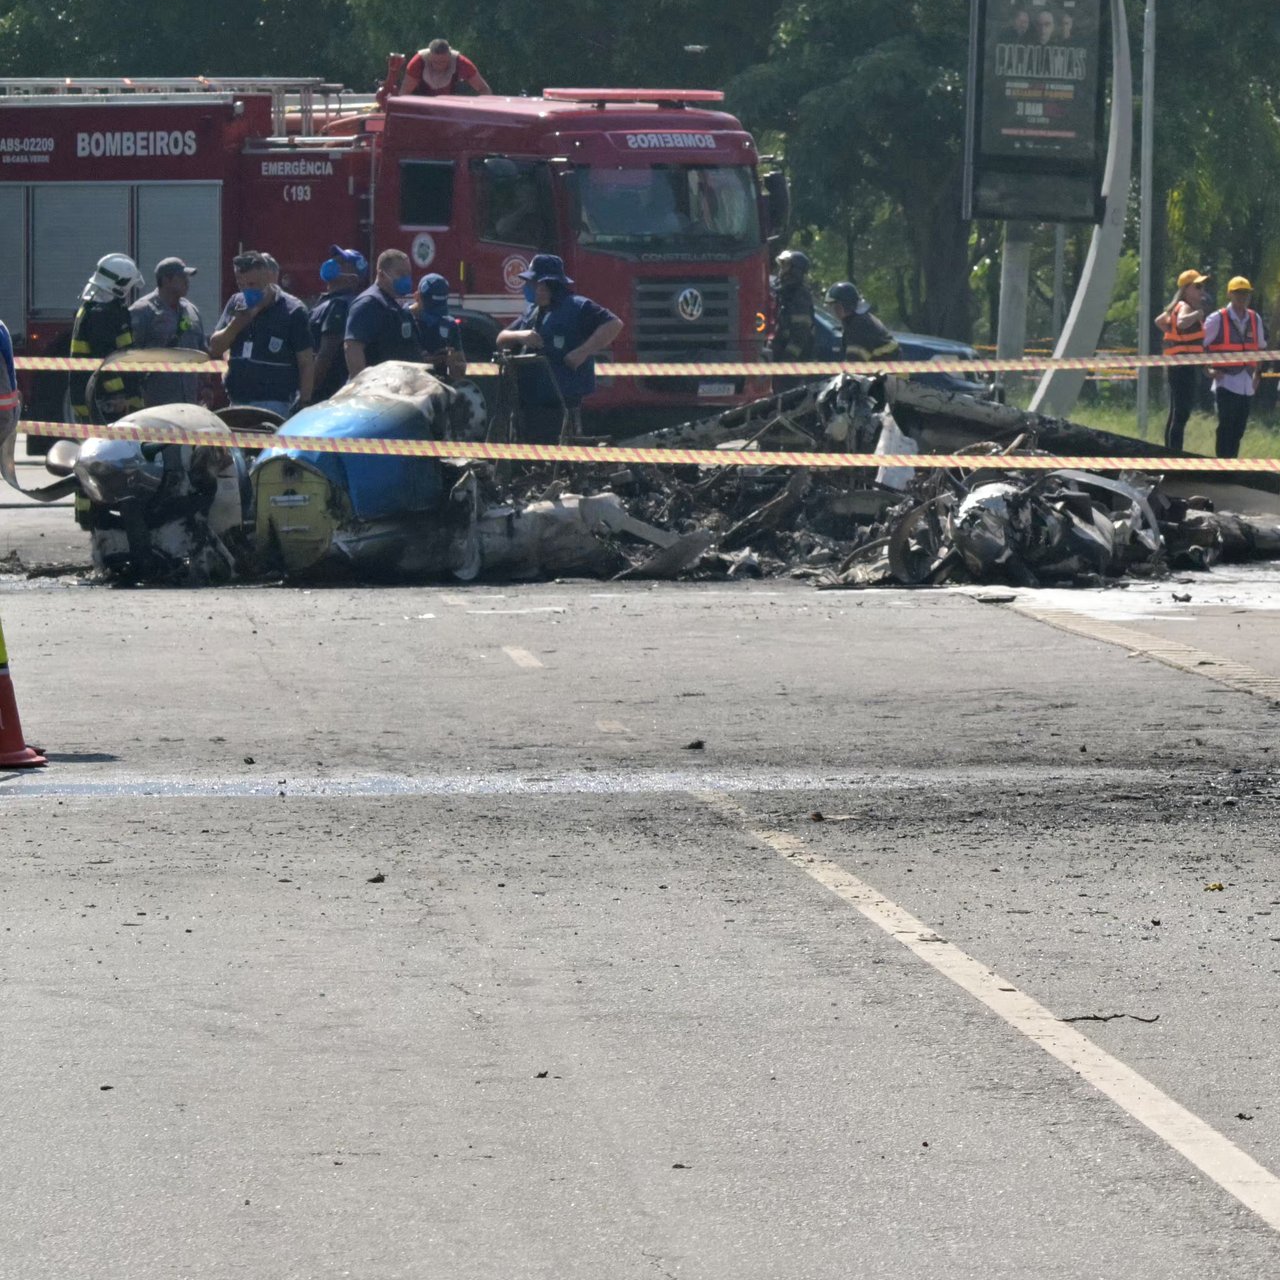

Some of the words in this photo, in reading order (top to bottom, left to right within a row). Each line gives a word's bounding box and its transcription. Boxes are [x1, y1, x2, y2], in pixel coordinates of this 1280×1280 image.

[0, 137, 54, 152] ABS-02209
[77, 130, 197, 157] BOMBEIROS
[262, 159, 333, 175] EMERGÊNCIA
